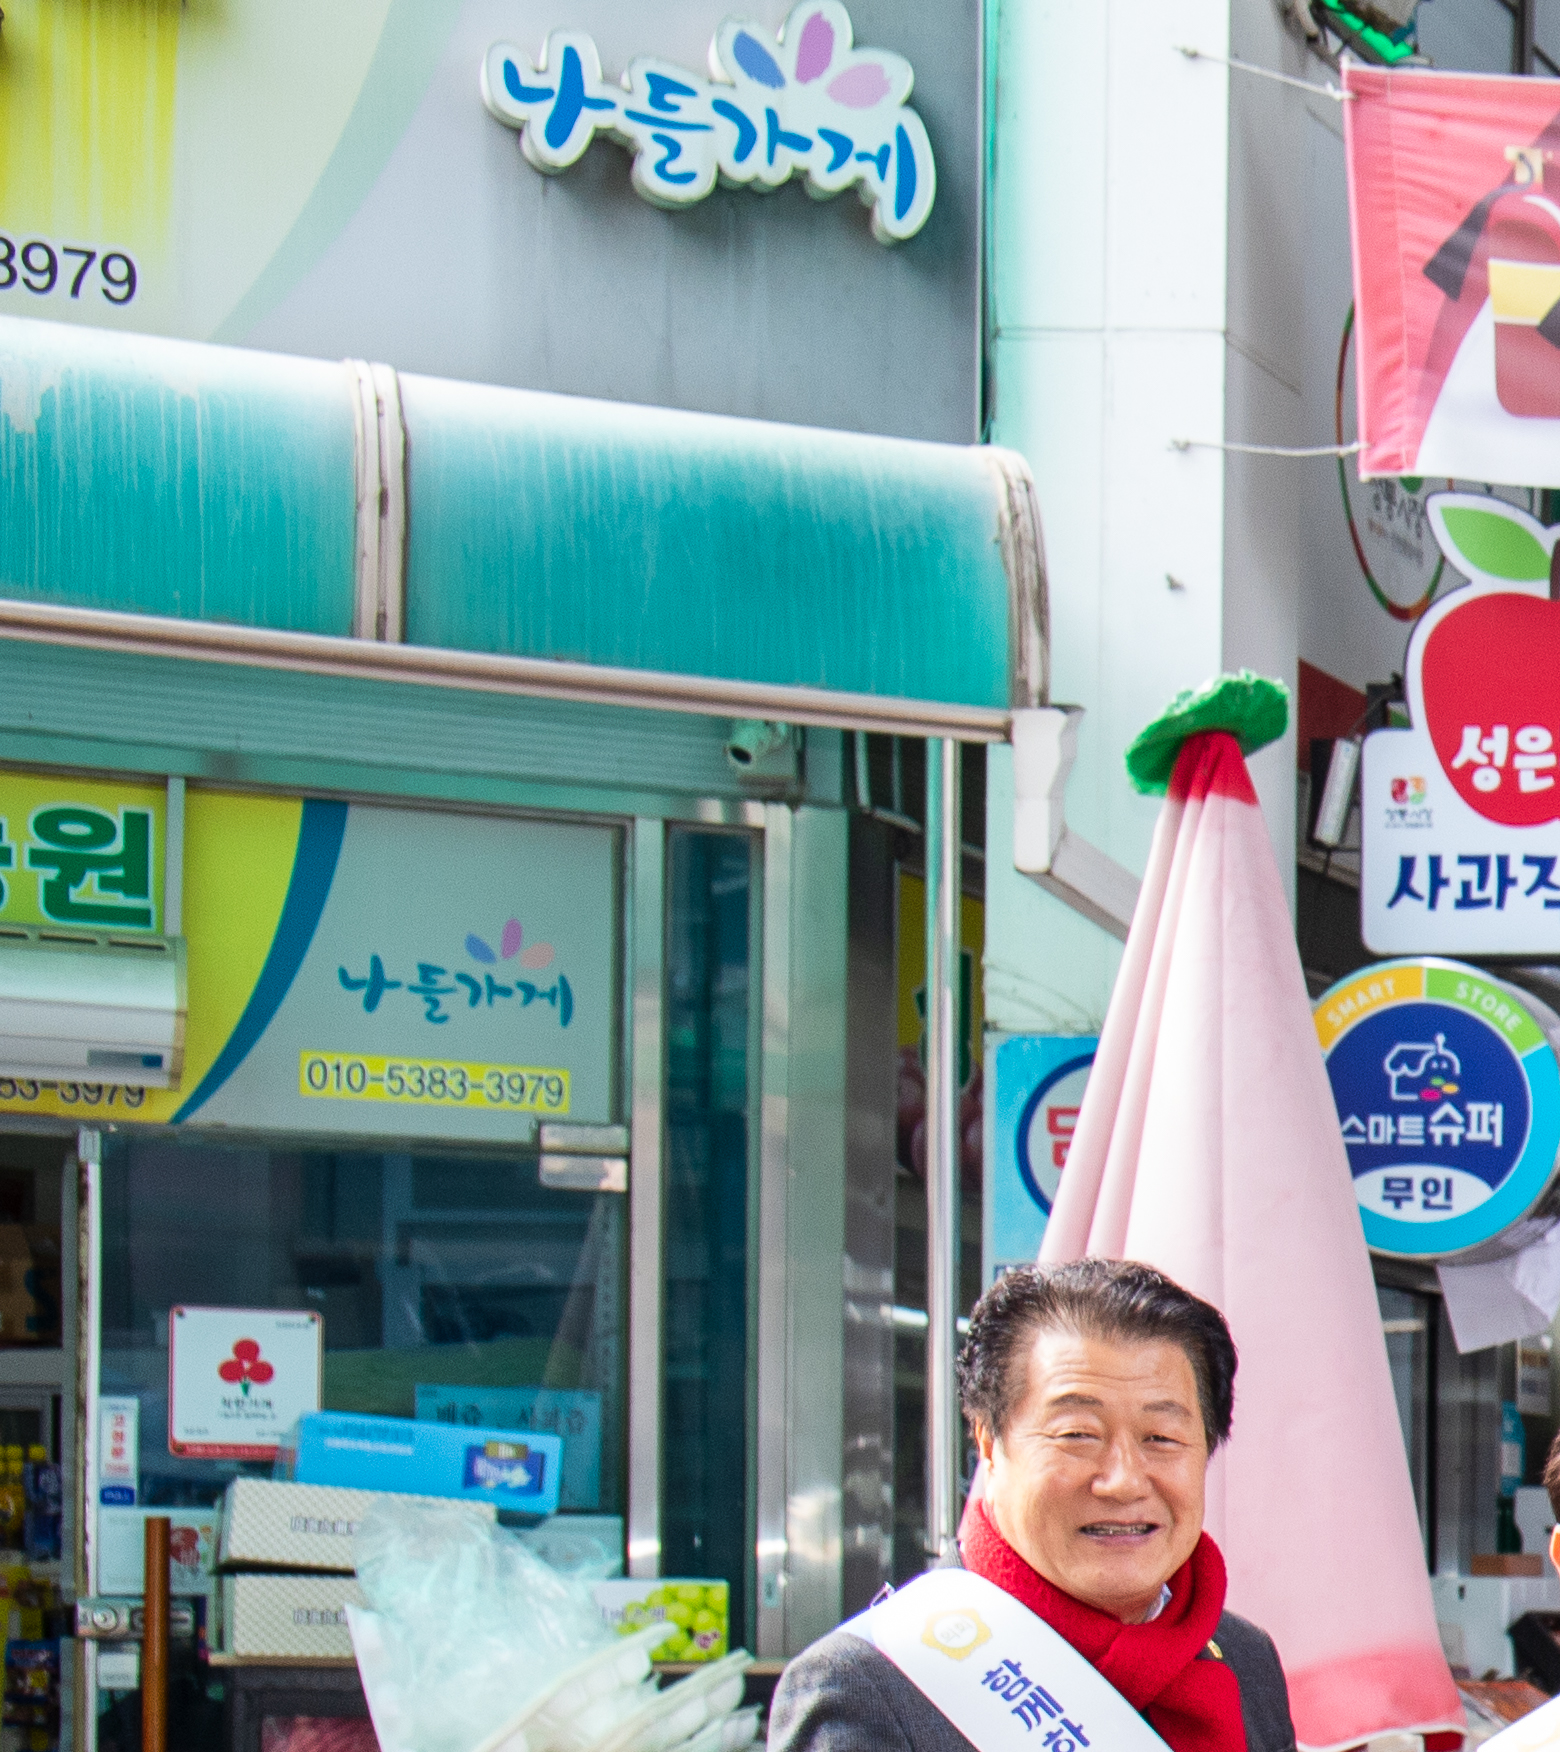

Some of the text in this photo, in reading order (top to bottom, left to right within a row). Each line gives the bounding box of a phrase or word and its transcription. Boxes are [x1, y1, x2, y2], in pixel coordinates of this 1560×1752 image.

[504, 57, 917, 222] 나들가게
[0, 811, 153, 928] 원
[338, 954, 574, 1028] 나들가게
[1325, 976, 1523, 1034] SMART STORE
[307, 1058, 565, 1108] 010-5383-3979
[1382, 1176, 1454, 1211] 무인
